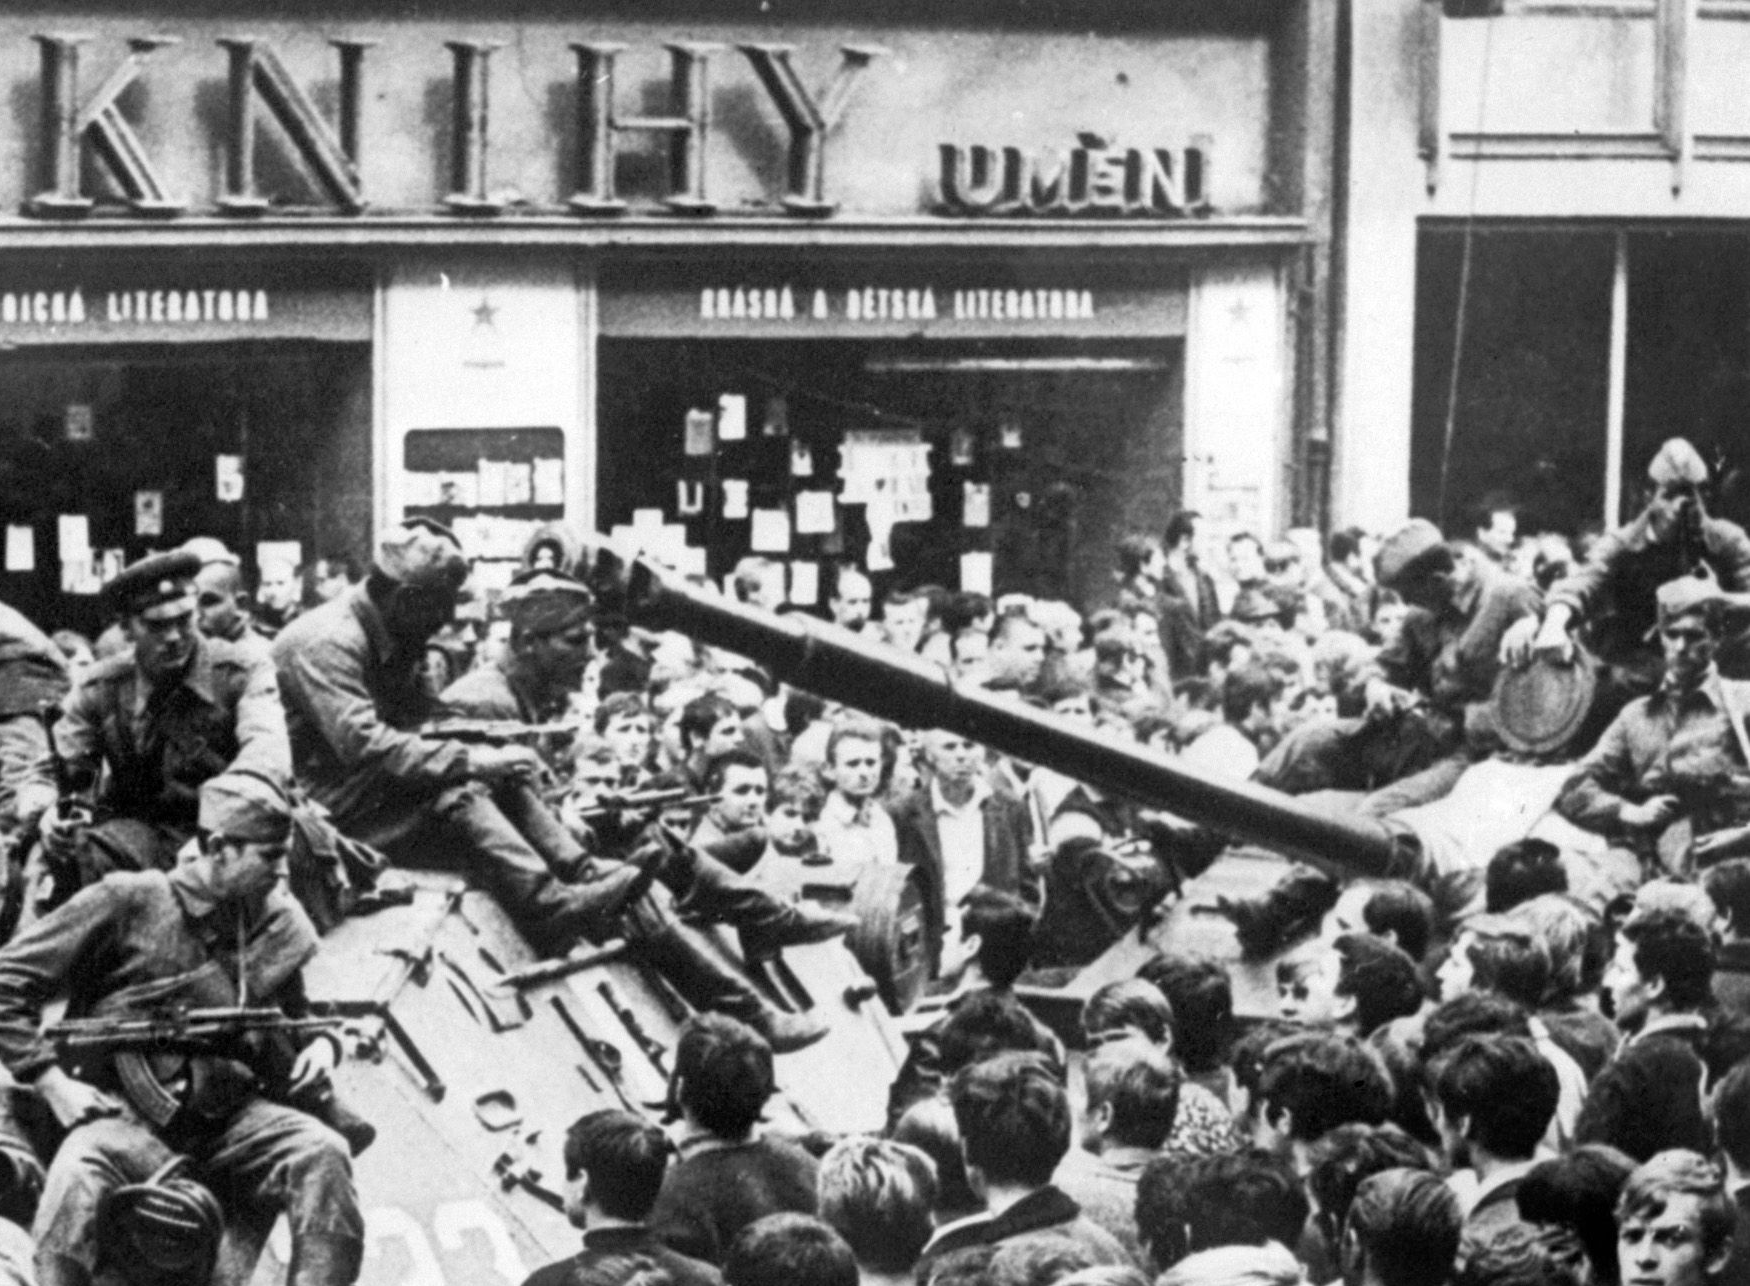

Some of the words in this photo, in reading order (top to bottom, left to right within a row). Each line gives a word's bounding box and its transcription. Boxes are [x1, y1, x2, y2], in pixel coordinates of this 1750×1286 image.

[30, 32, 886, 214] KNIHY
[105, 289, 268, 322] LITERATURA
[812, 288, 827, 319] A
[954, 288, 1096, 320] LITERATURA
